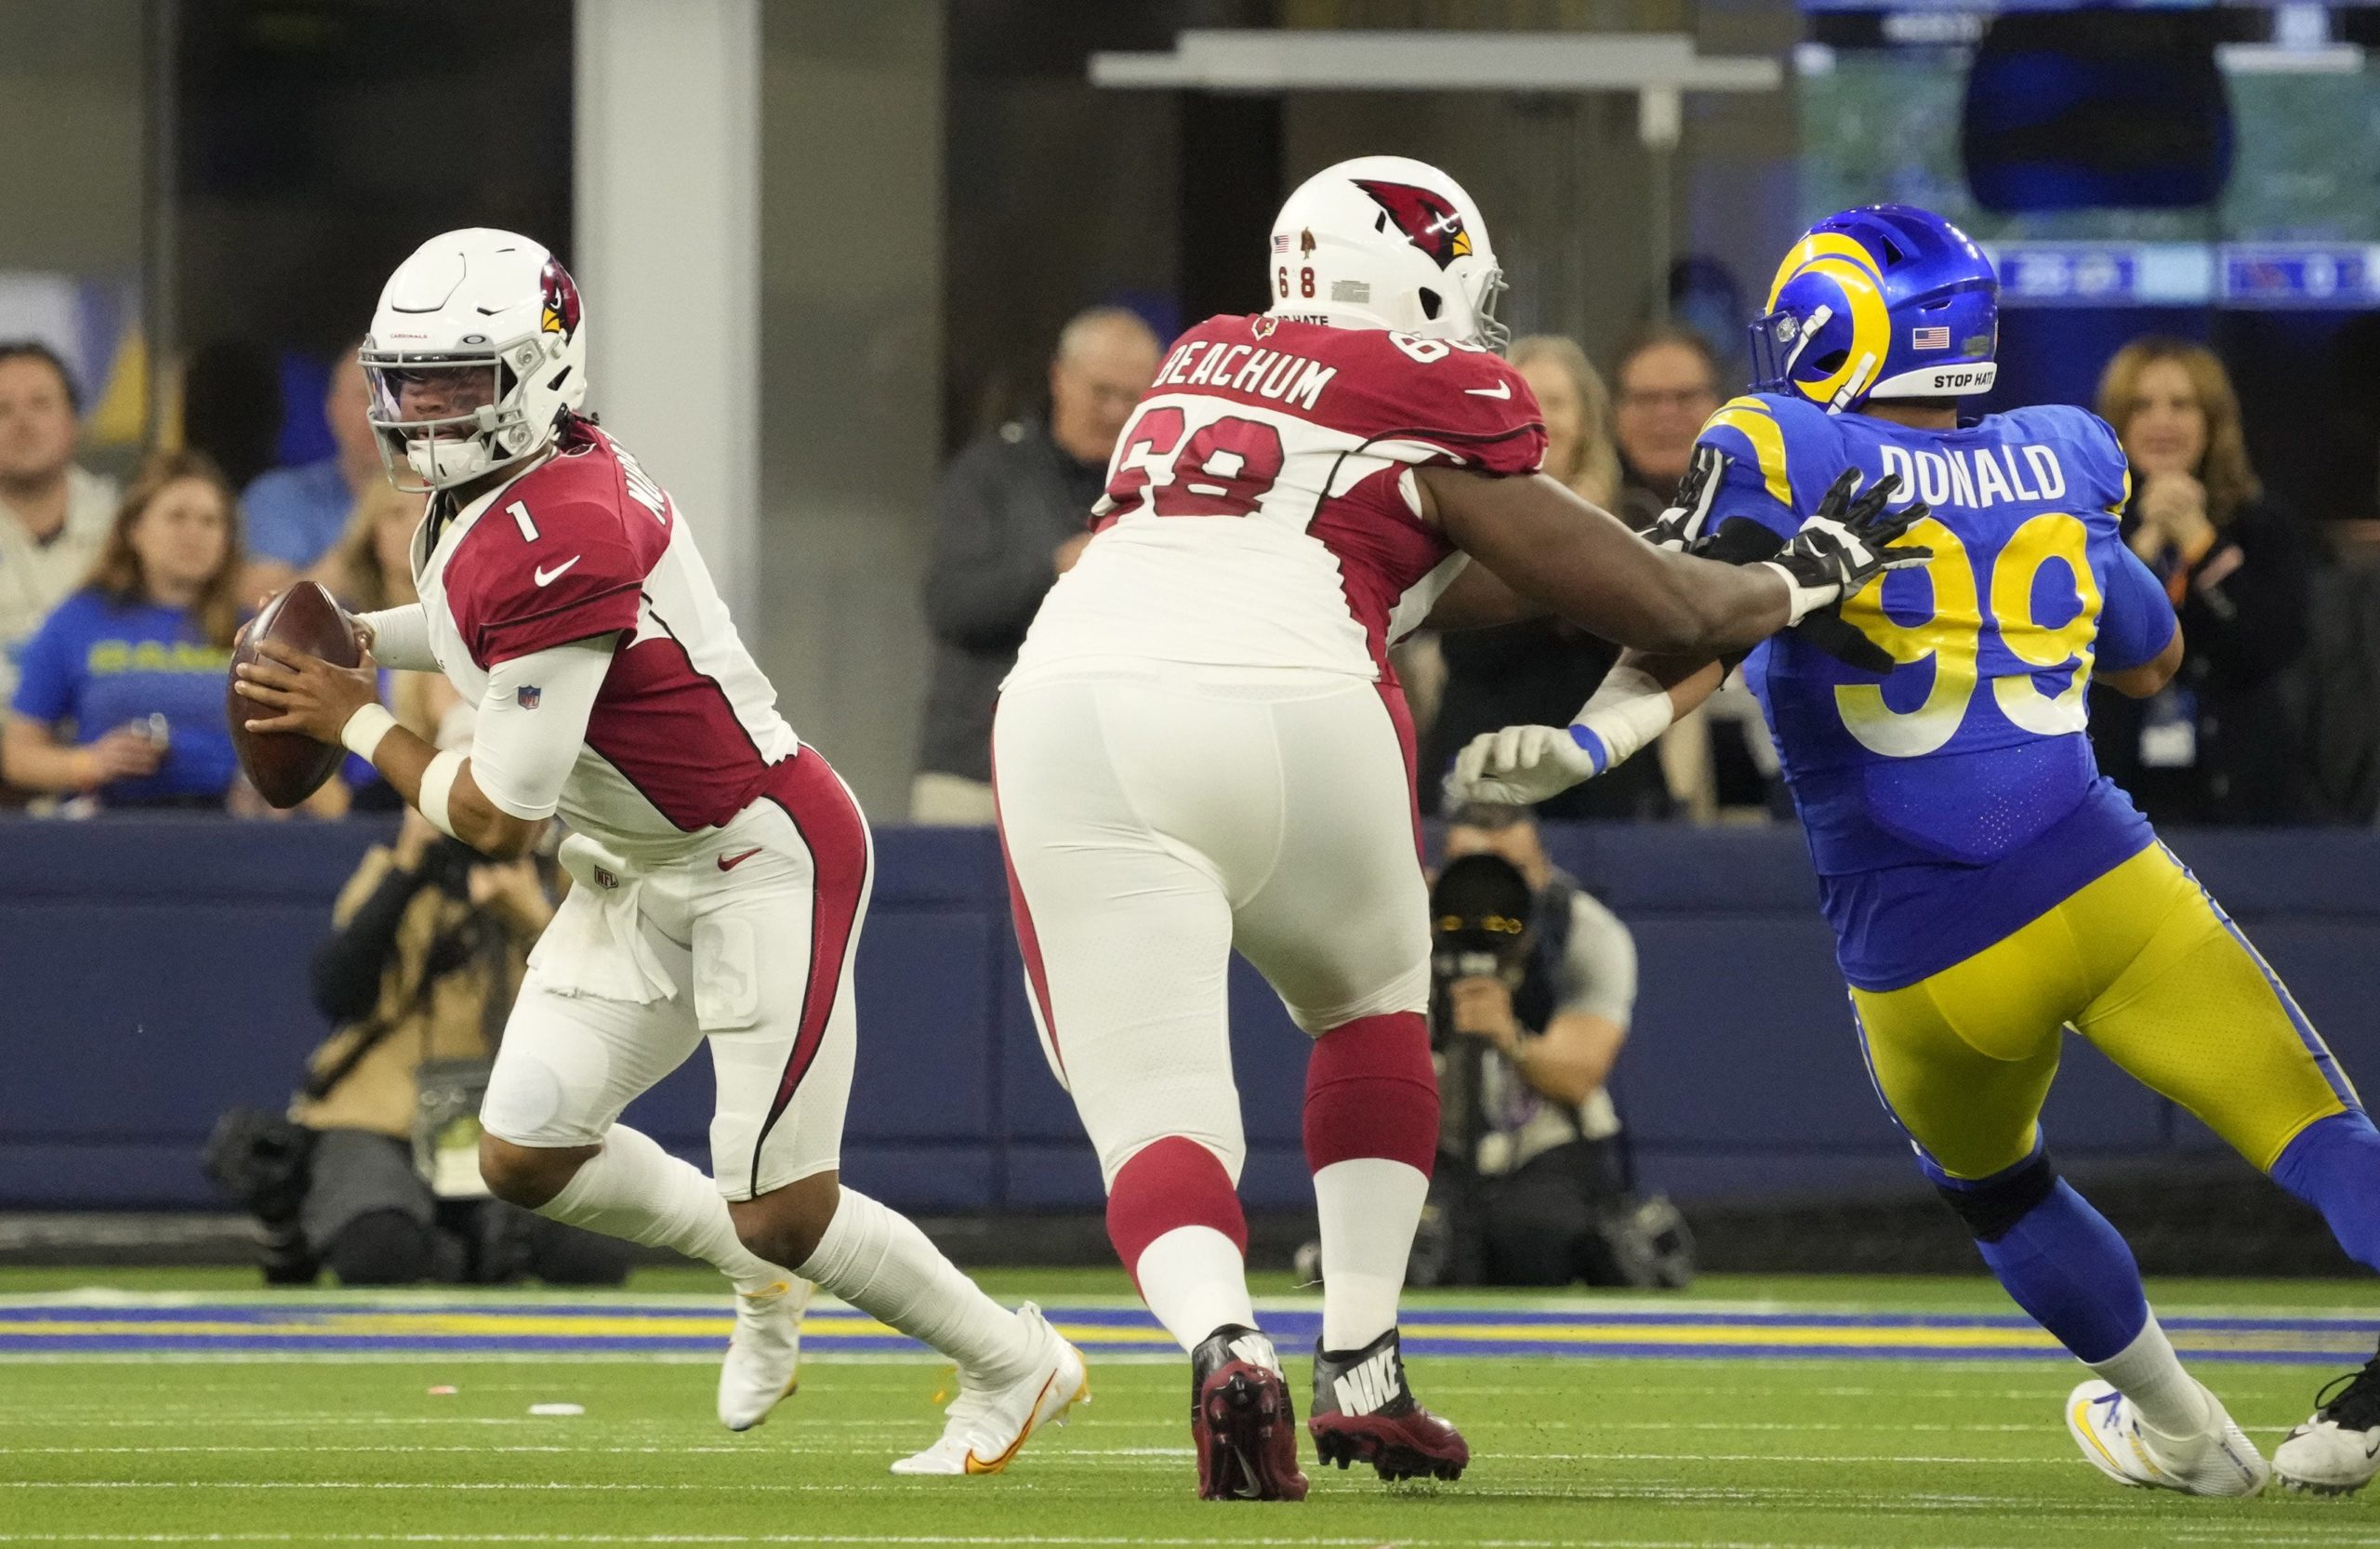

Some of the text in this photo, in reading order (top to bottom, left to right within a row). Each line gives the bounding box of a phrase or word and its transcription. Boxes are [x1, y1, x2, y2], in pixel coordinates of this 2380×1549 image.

[1152, 340, 1337, 411] BEACHUM
[1935, 371, 1994, 389] STOP HATE
[1108, 406, 1284, 517] 68
[1880, 444, 2066, 509] DONALD
[506, 500, 540, 542] 1
[1834, 512, 2103, 758] 99
[596, 867, 616, 888] NFL
[1333, 1345, 1401, 1418] NIKE
